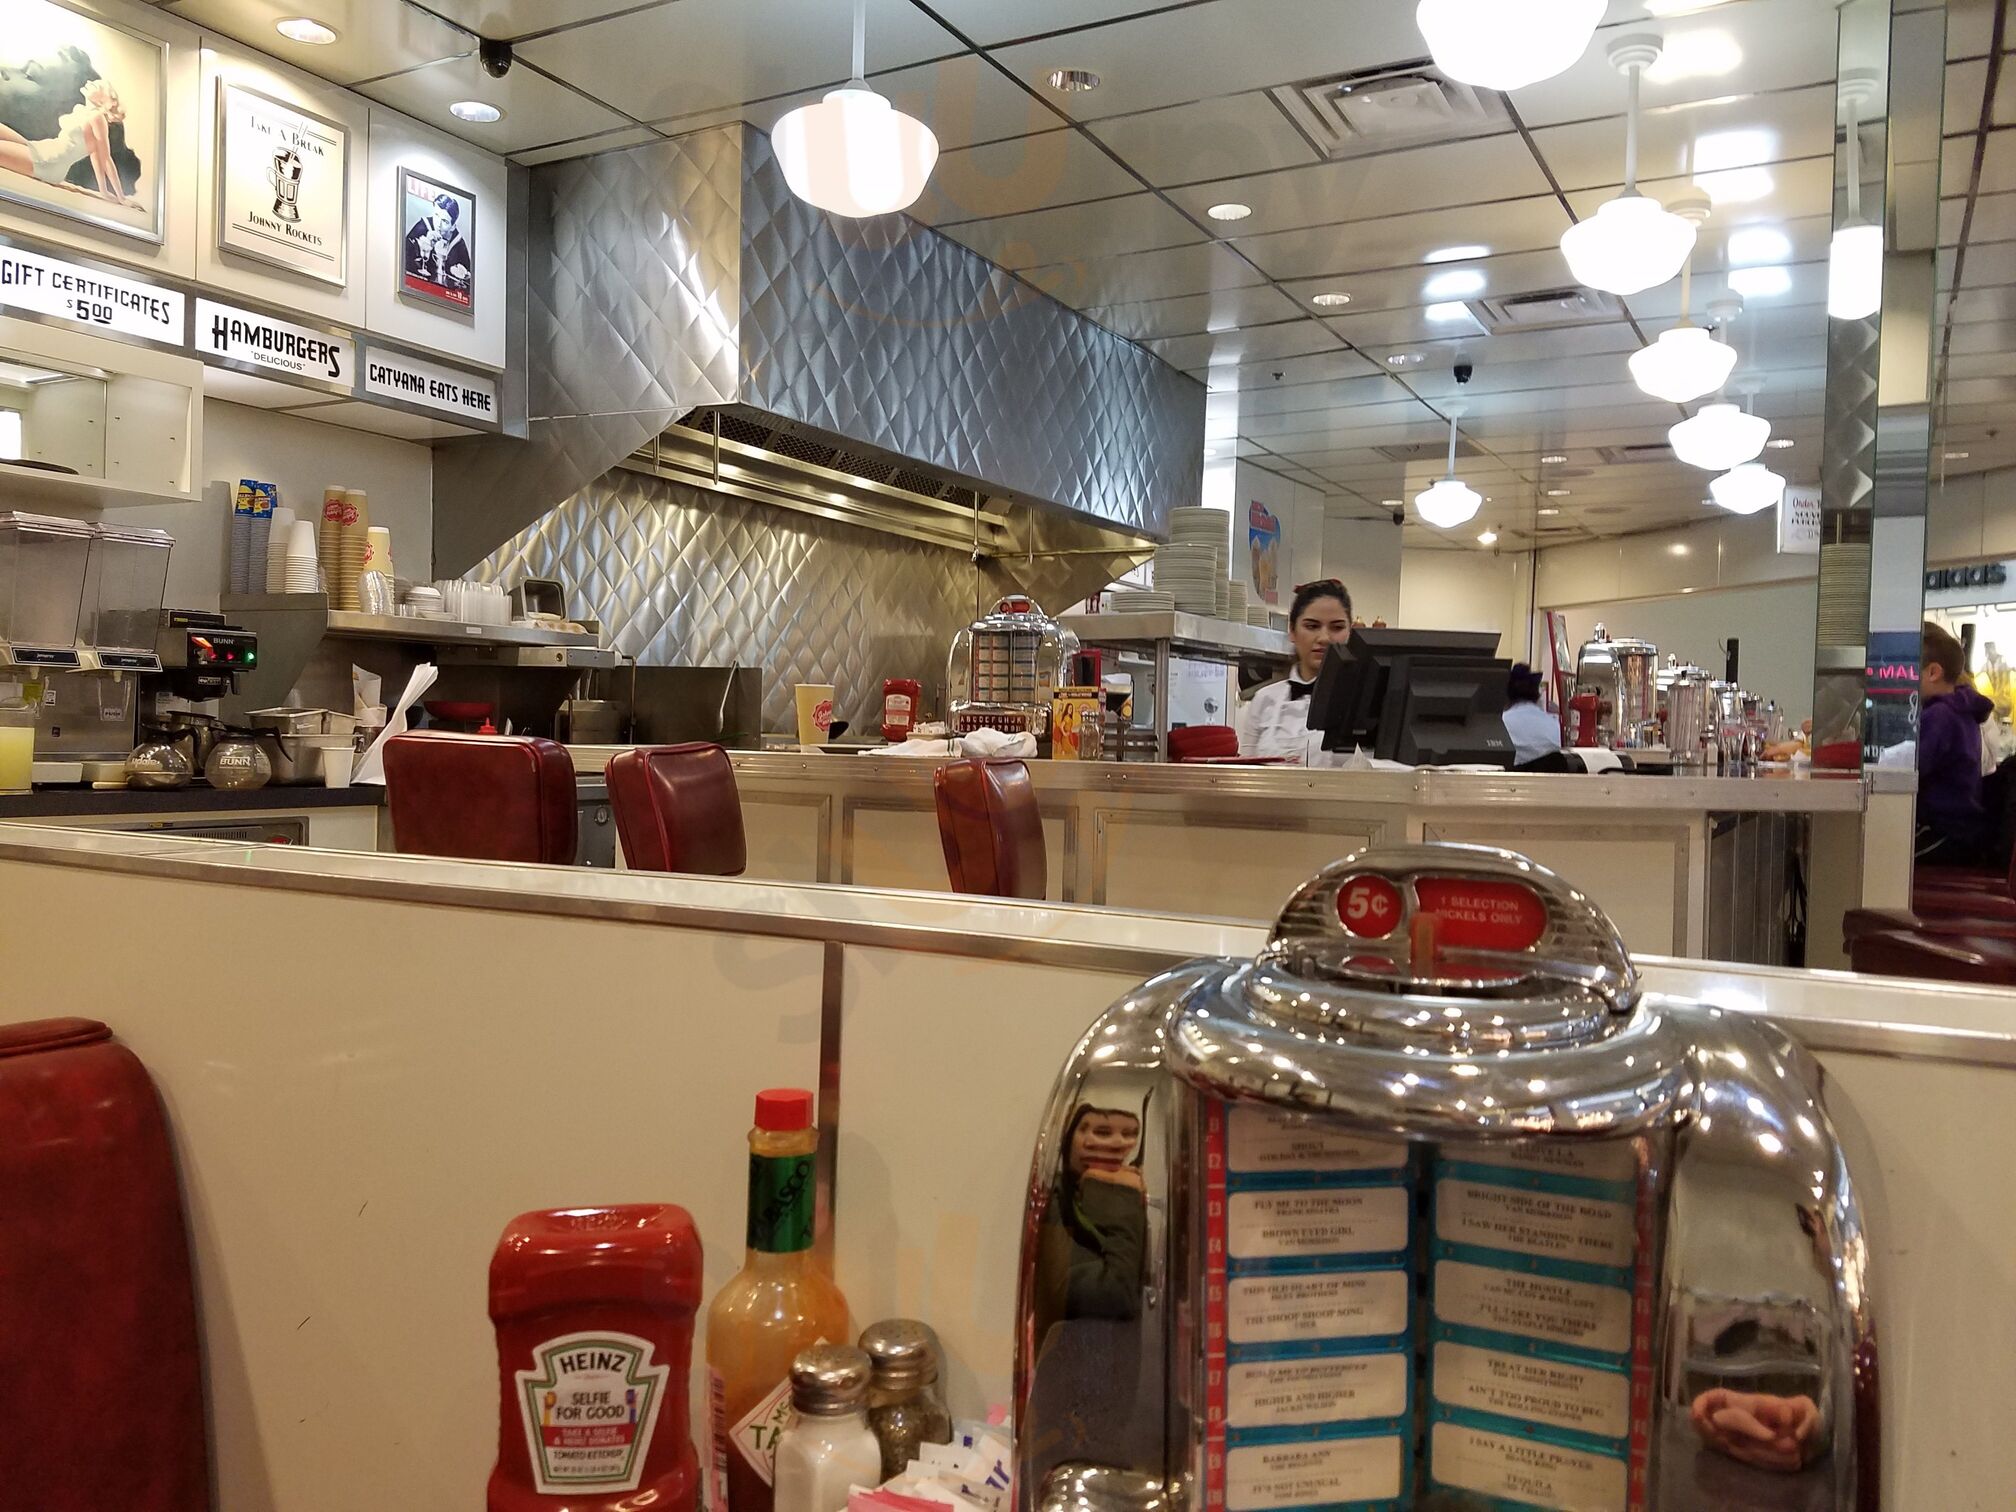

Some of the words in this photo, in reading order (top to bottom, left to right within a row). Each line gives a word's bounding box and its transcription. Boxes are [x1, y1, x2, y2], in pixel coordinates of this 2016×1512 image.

[292, 132, 324, 156] BREAK
[248, 211, 281, 232] JOHNNY
[286, 223, 322, 246] ROCKETS
[1, 259, 44, 290] GIFT
[52, 272, 170, 326] CERTIFICATES
[211, 314, 340, 378] HAMBURGERS
[369, 364, 426, 396] CATYANA
[429, 371, 459, 402] EATS
[462, 382, 492, 412] HERE
[213, 637, 235, 645] BUNN
[219, 758, 251, 767] BUNN
[1451, 896, 1520, 911] SELECTION
[1490, 912, 1522, 924] ONLY
[1208, 1201, 1221, 1217] E3
[1208, 1238, 1222, 1254] E4
[560, 1353, 627, 1374] HEINZ
[571, 1391, 611, 1406] SELFIE
[556, 1406, 581, 1420] FOR
[586, 1405, 624, 1420] GOOD
[553, 1451, 586, 1460] TOMATO
[587, 1450, 624, 1459] KETCHUP
